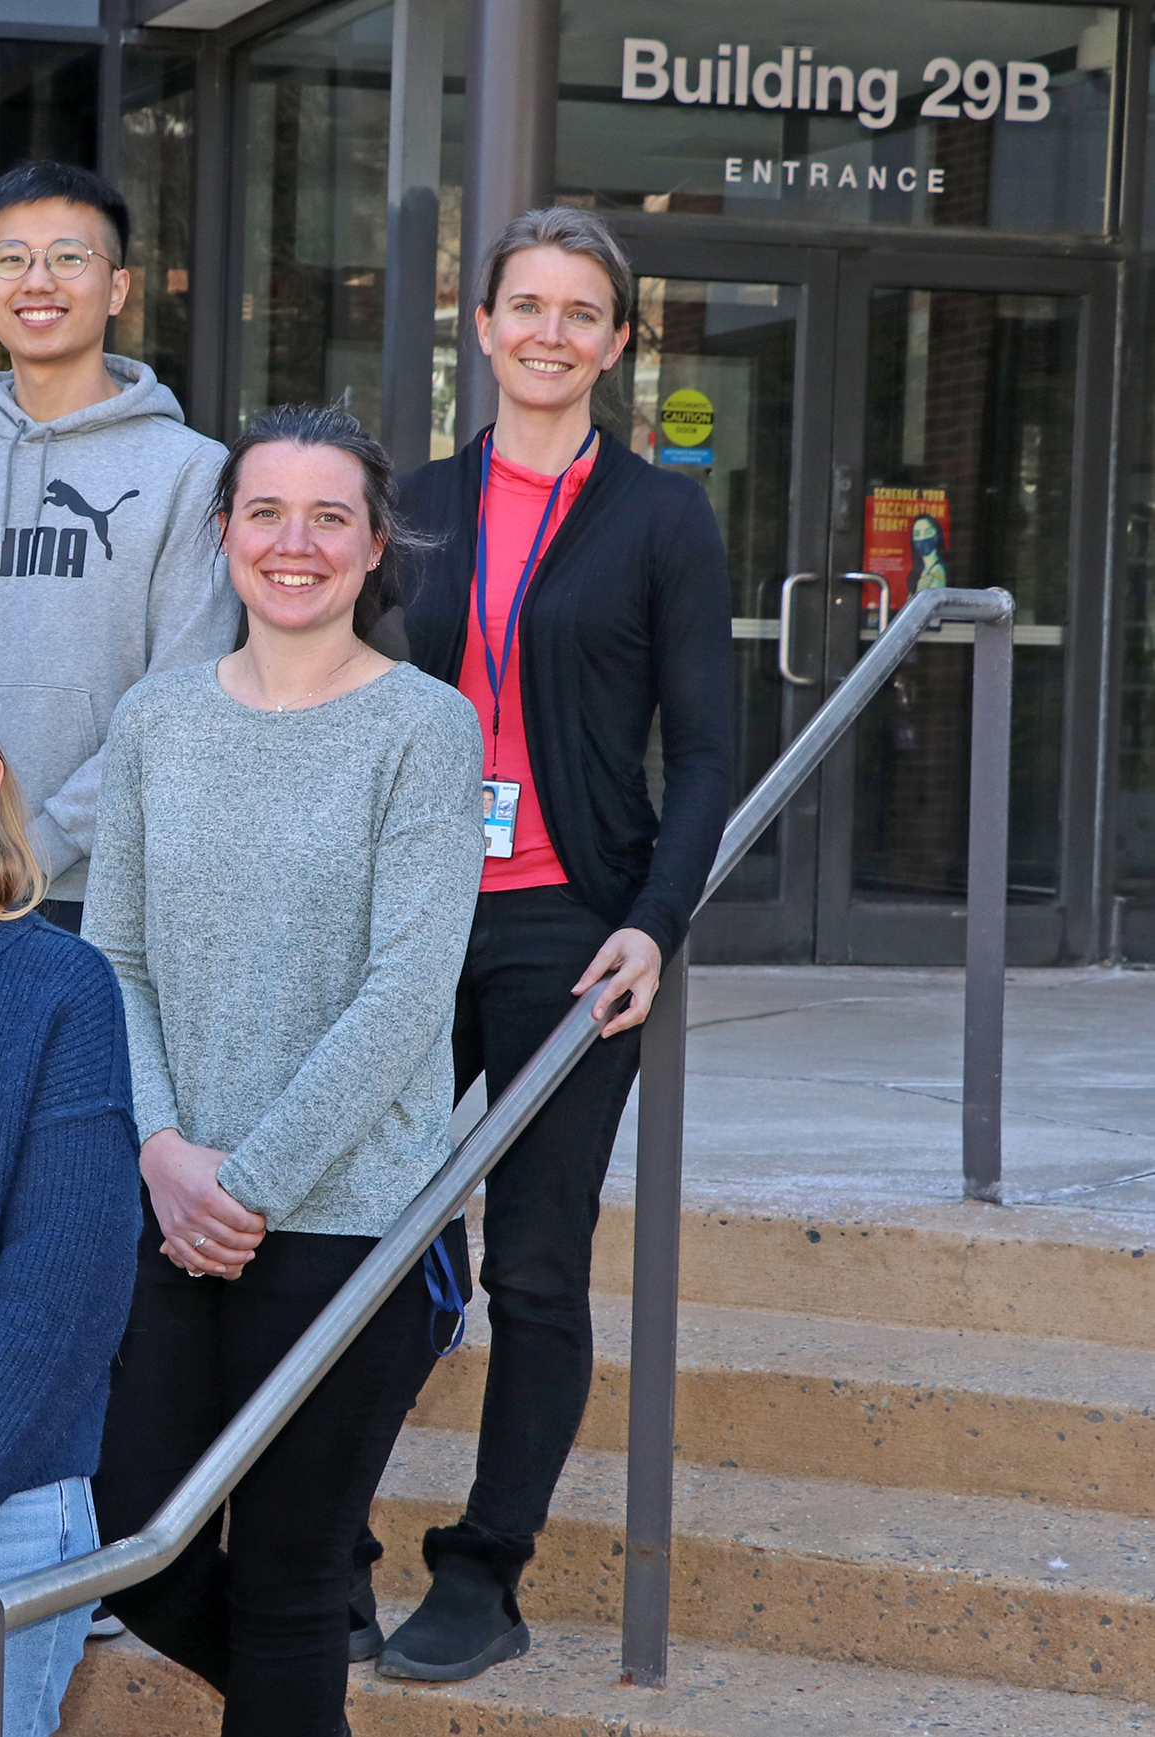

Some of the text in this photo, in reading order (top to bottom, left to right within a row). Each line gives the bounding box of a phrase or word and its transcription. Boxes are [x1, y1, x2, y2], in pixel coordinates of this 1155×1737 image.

[621, 38, 1051, 129] Building 29B
[725, 157, 945, 193] ENTRANCE
[663, 411, 711, 423] CAUTION
[874, 488, 945, 501] SCHEDULE YOUR
[874, 503, 945, 517] VACCINATION
[873, 518, 908, 531] TODAY!
